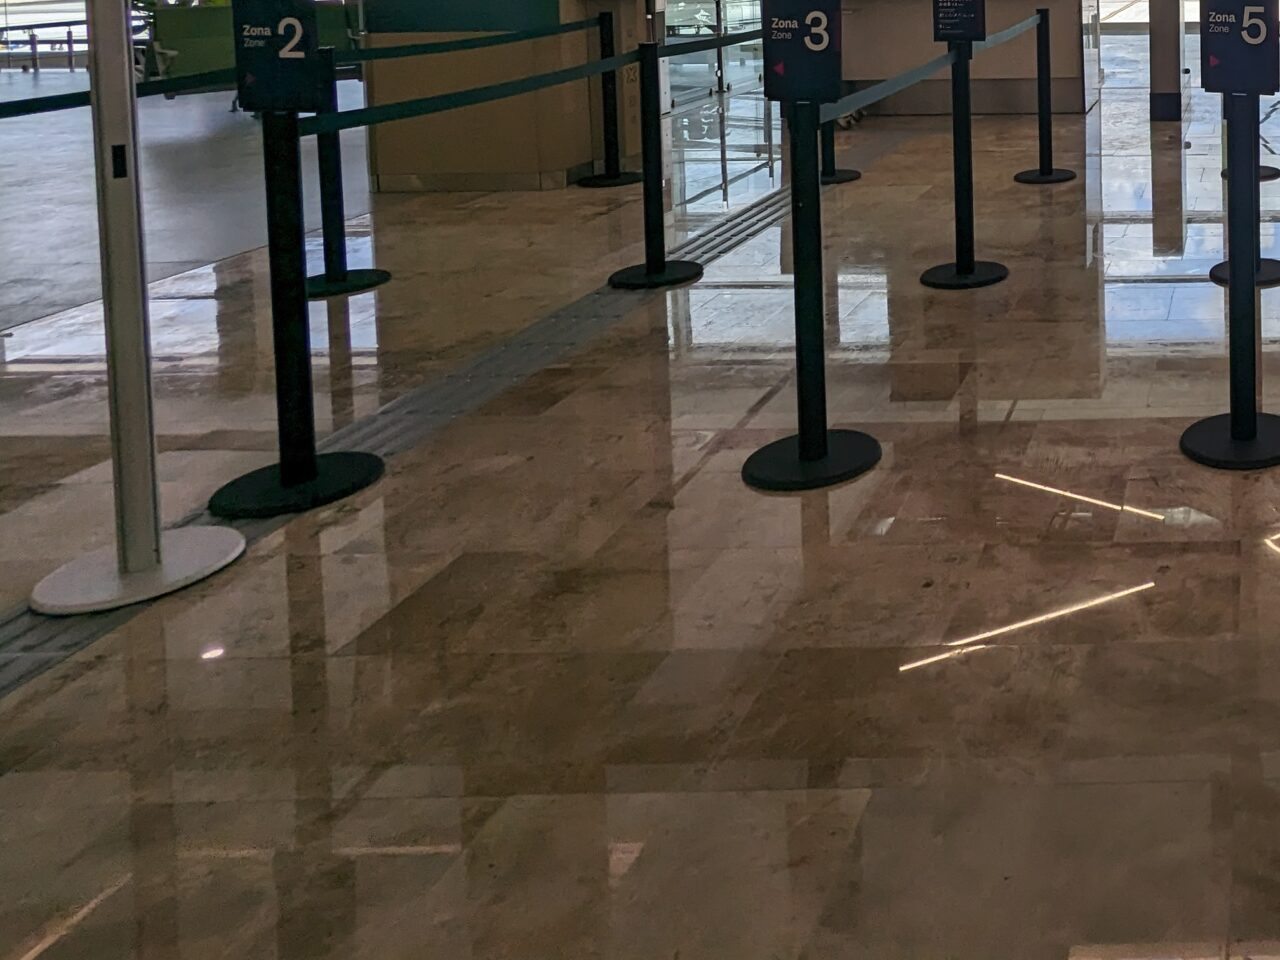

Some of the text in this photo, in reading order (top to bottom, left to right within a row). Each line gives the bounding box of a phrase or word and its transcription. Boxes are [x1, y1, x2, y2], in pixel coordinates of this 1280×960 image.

[242, 17, 306, 59] Zona 2
[771, 10, 830, 52] Zona 3
[771, 30, 793, 40] Zone
[1208, 5, 1267, 46] Zona 5
[1208, 23, 1230, 33] Zone
[243, 37, 265, 48] Zone
